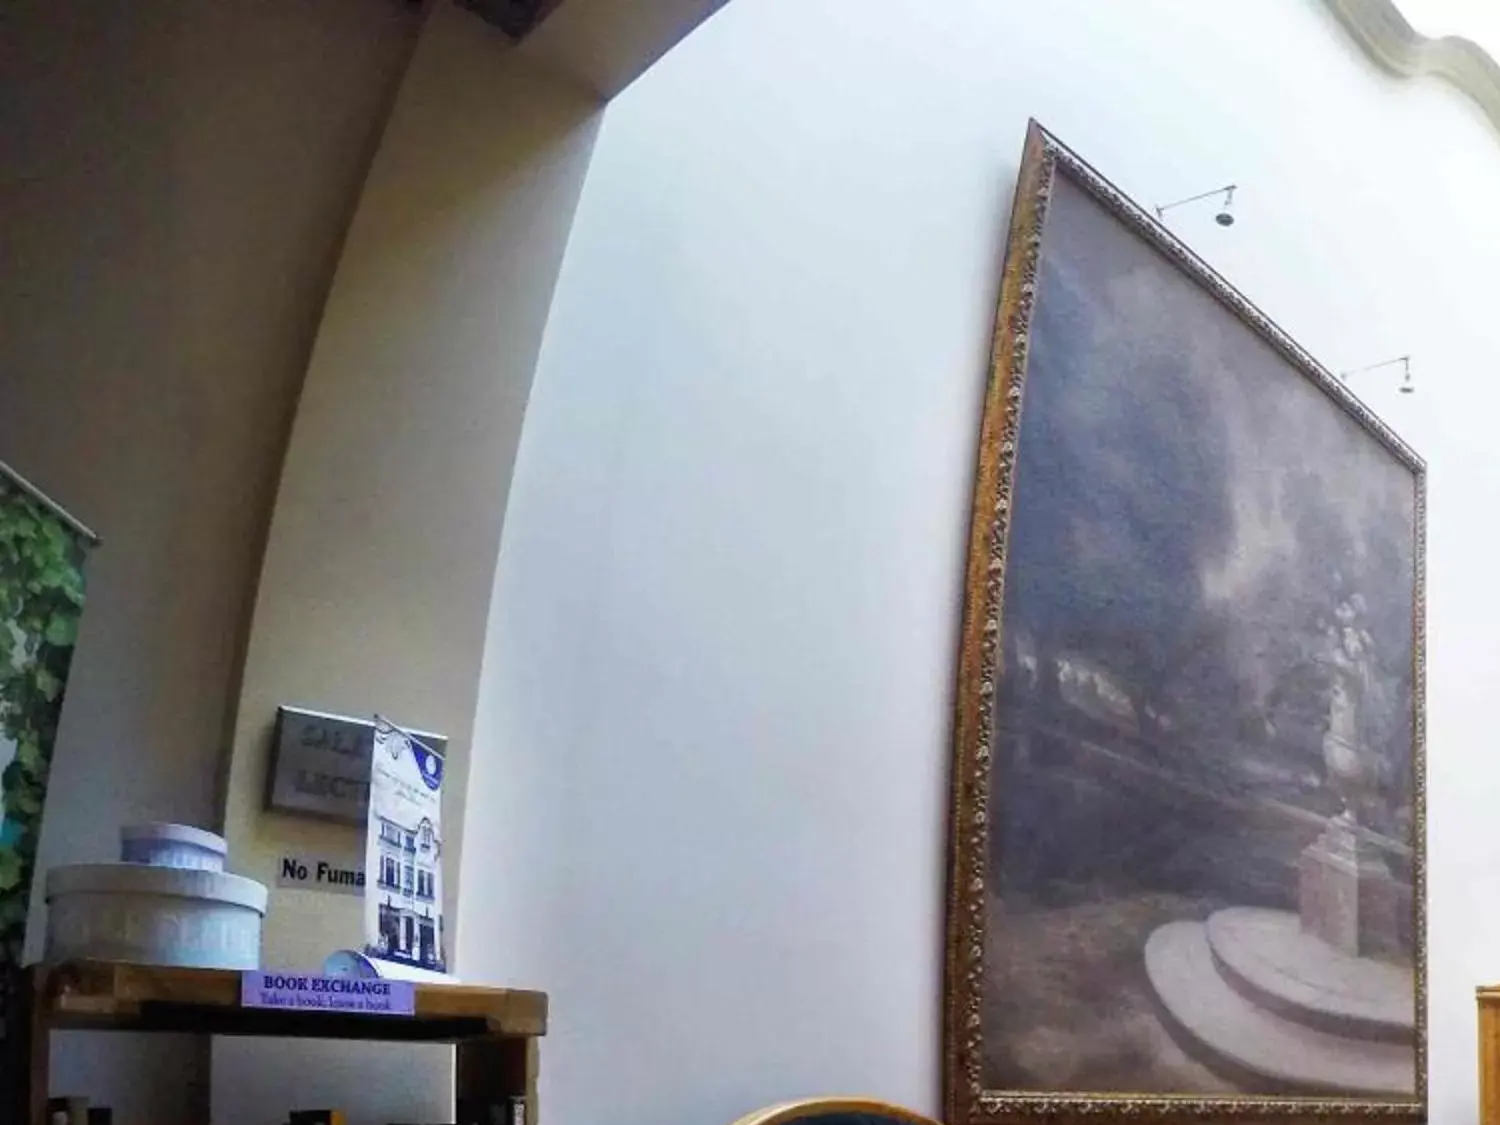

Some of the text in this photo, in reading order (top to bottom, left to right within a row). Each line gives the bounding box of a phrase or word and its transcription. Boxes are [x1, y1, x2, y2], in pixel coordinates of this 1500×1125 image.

[294, 767, 369, 803] LECT
[282, 858, 366, 887] No Fuma
[263, 975, 391, 996] BOOK EXCHANGE
